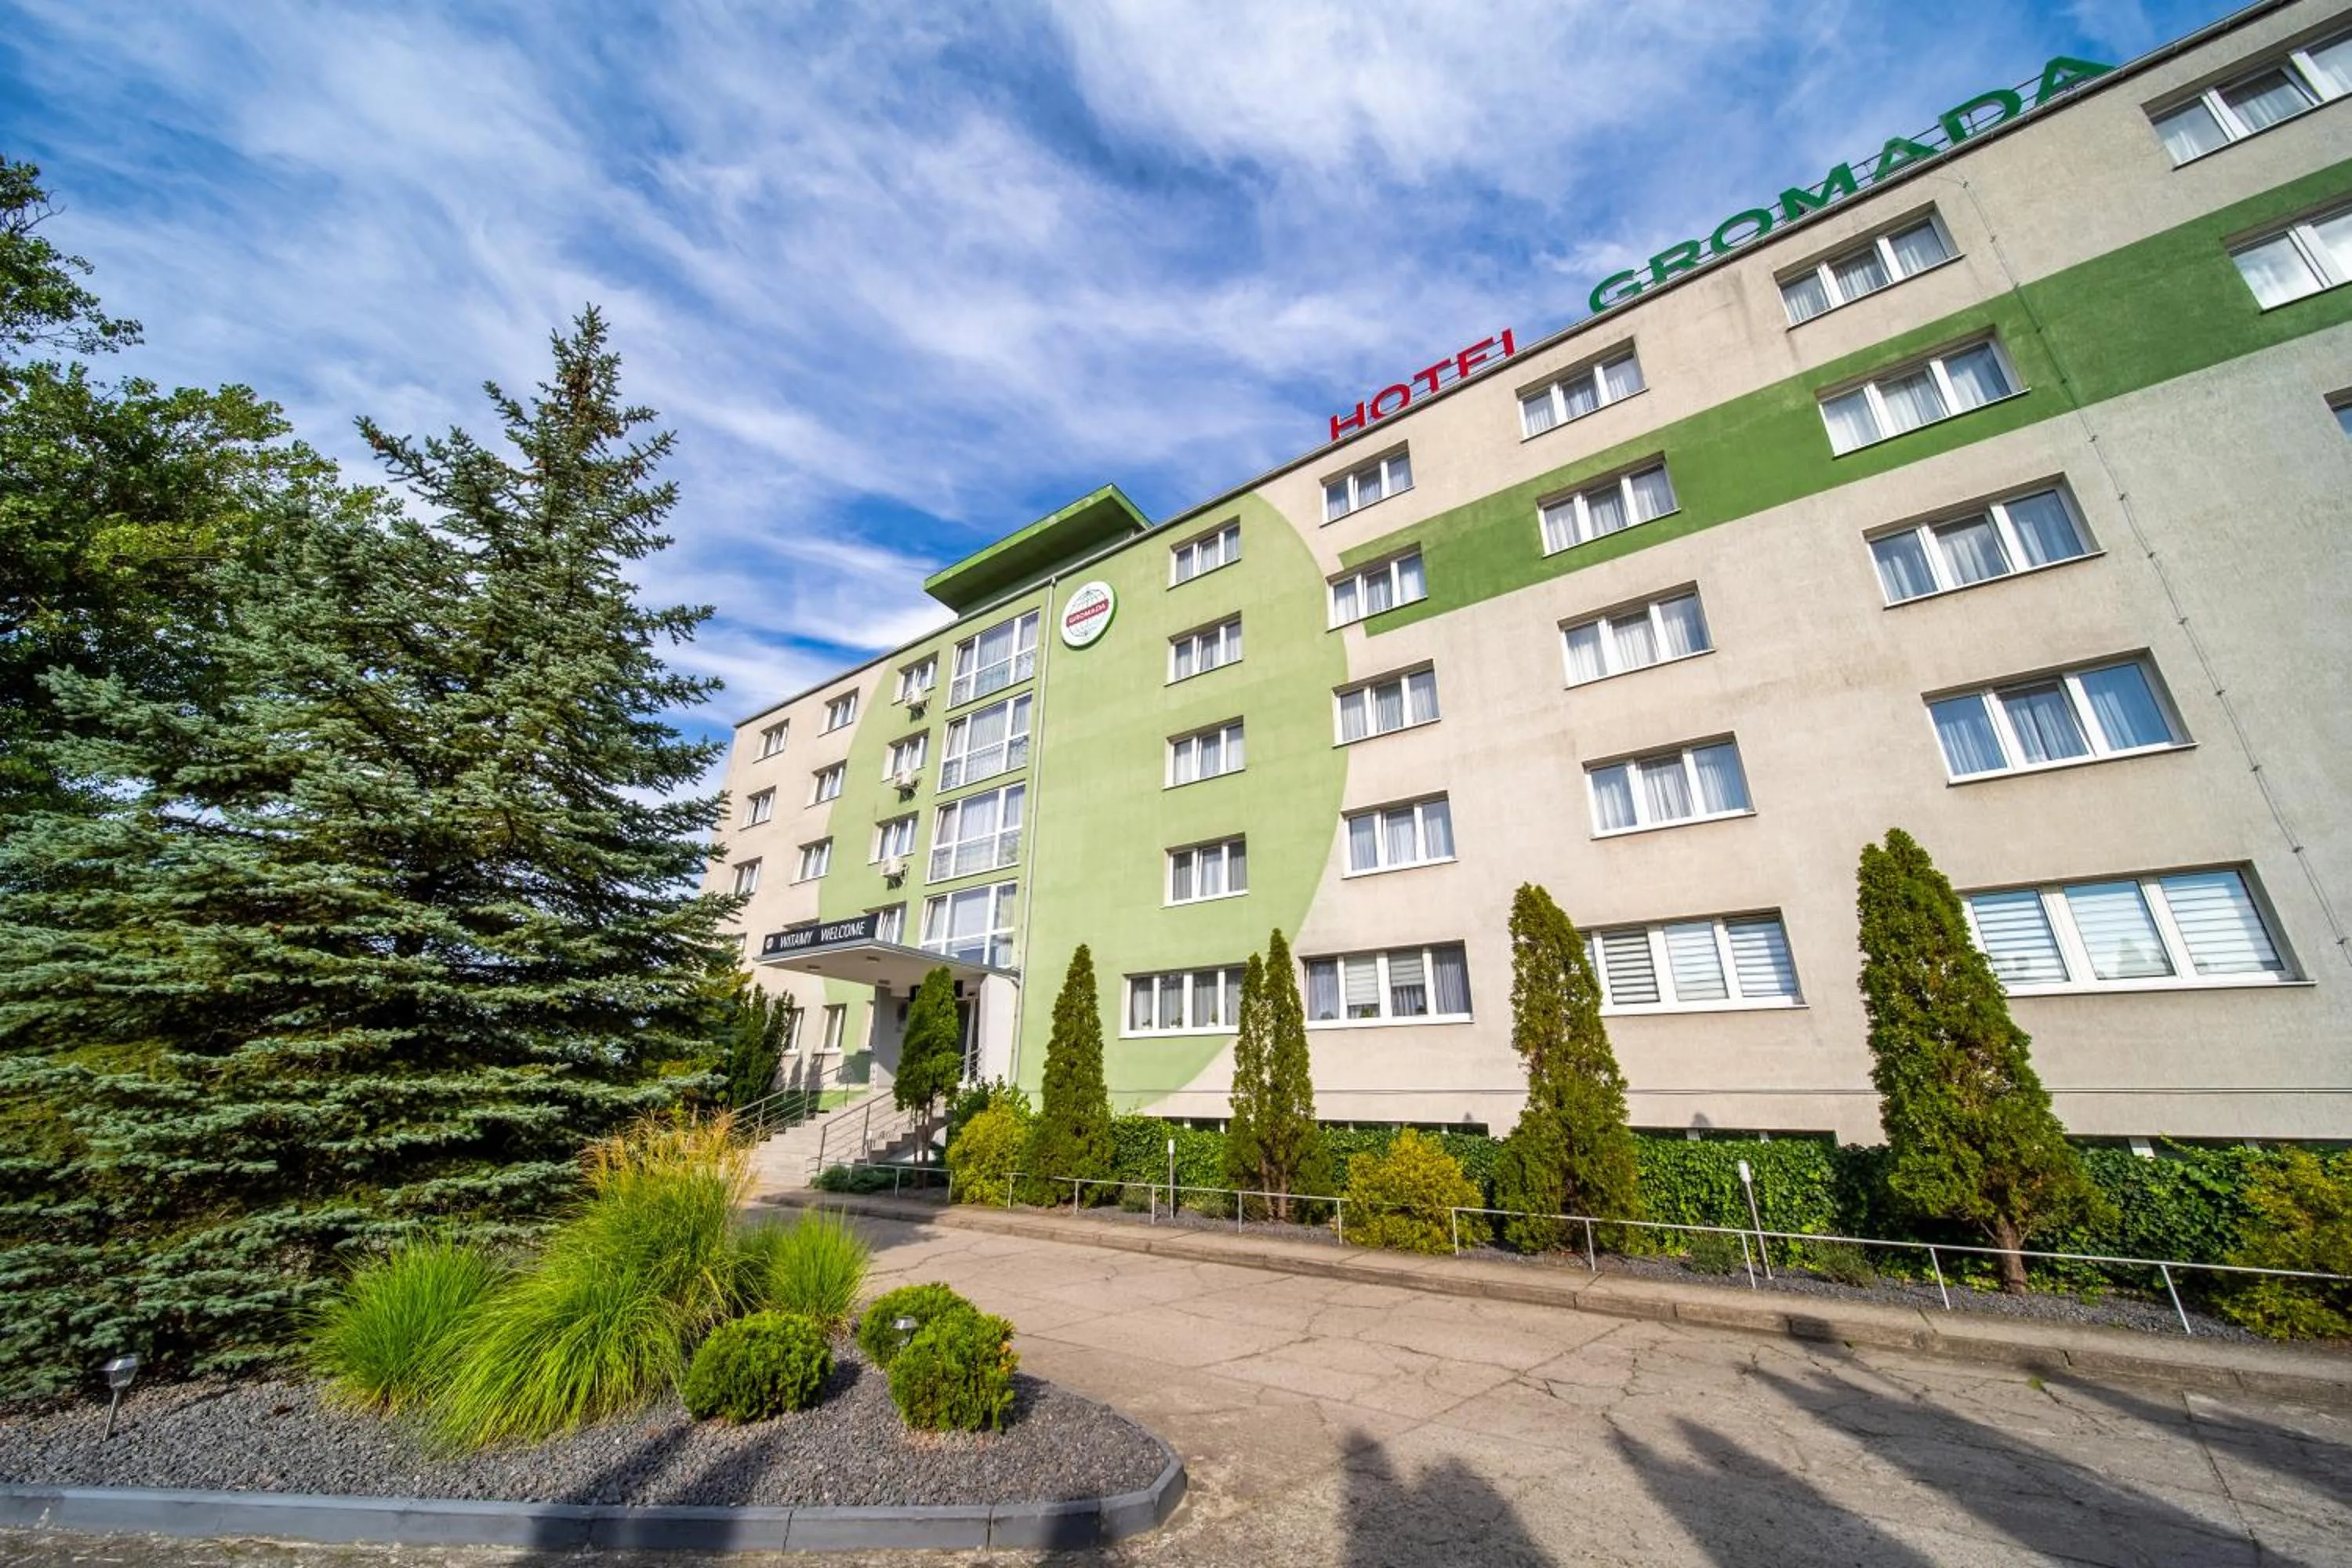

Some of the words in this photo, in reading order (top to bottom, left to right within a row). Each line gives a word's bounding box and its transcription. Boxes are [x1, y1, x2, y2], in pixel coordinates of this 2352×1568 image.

[1588, 56, 2116, 314] GROMADA
[779, 930, 814, 949] WITAMY
[820, 921, 866, 942] WELCOME
